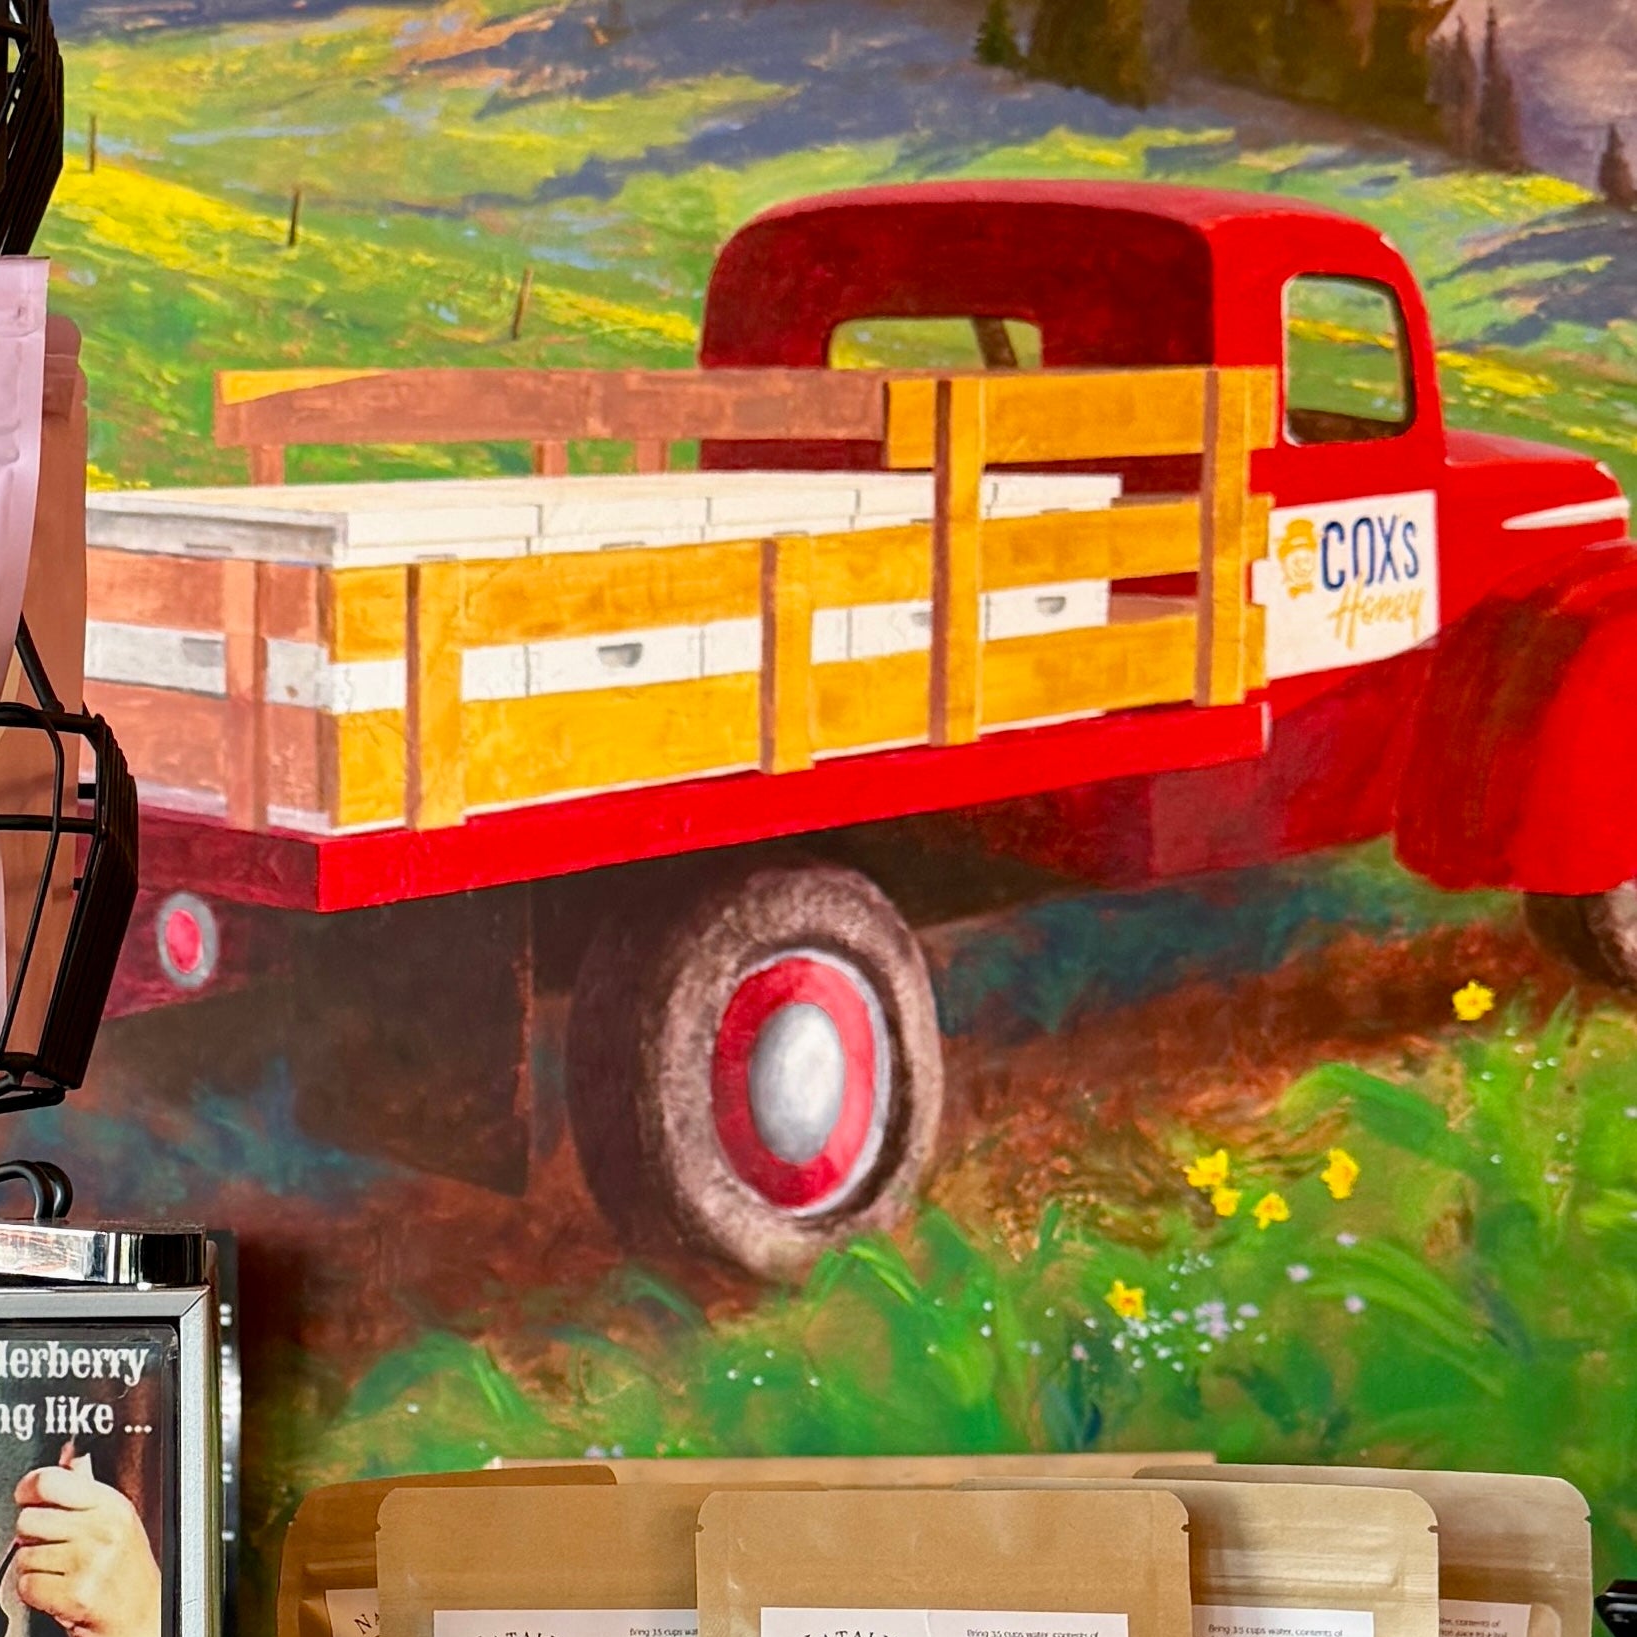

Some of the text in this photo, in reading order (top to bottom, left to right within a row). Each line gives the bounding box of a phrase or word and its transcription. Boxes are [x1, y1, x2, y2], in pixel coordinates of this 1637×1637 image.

[1322, 514, 1419, 591] COXS
[1326, 572, 1425, 650] Honey
[45, 1396, 114, 1434] like
